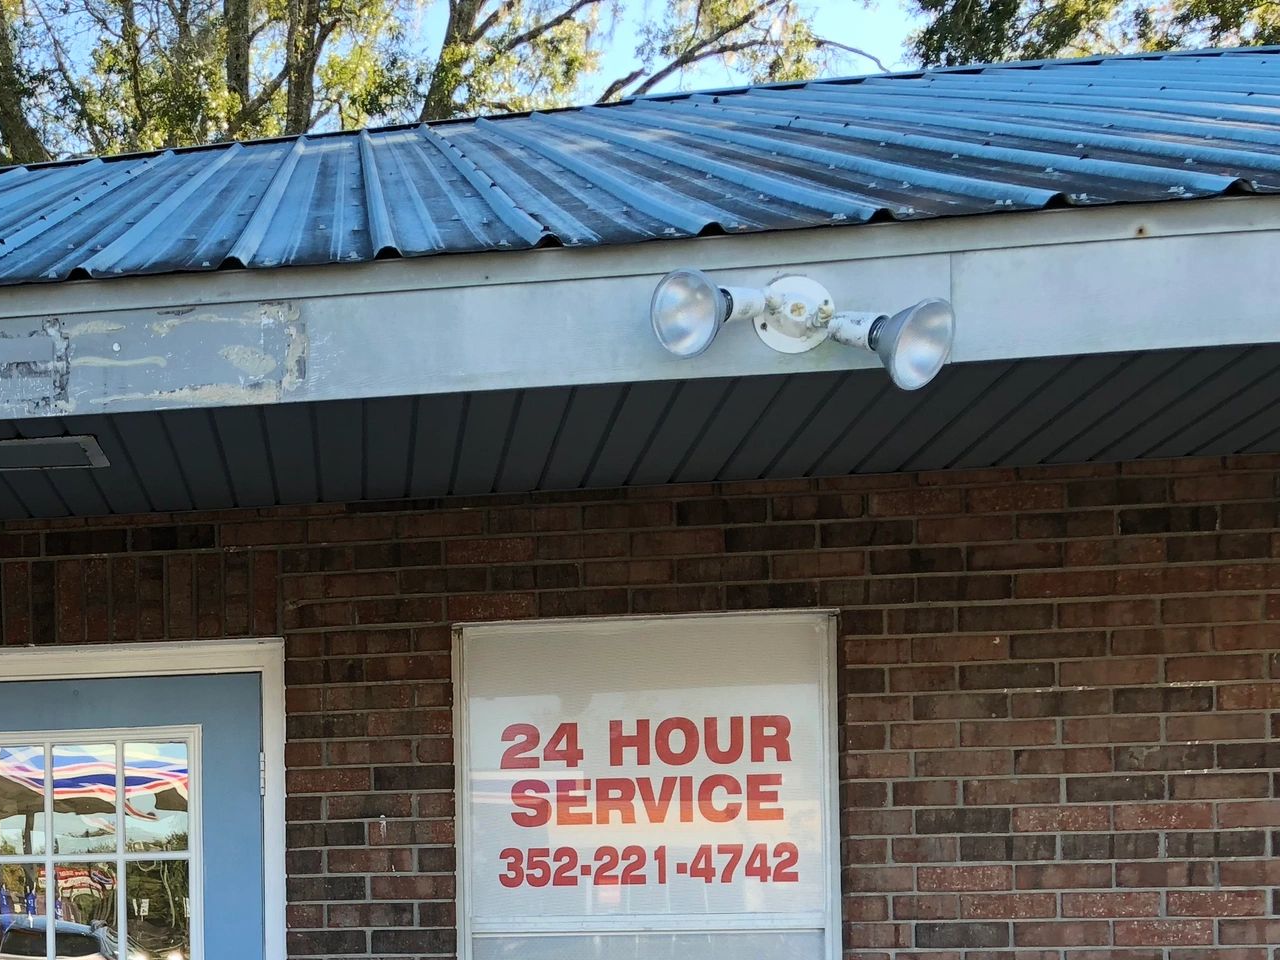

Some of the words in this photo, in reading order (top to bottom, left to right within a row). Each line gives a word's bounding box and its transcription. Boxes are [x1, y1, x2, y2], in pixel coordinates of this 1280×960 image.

[500, 722, 584, 770] 24
[609, 715, 792, 768] HOUR
[510, 773, 785, 828] SERVICE
[499, 842, 799, 888] 352-221-4742
